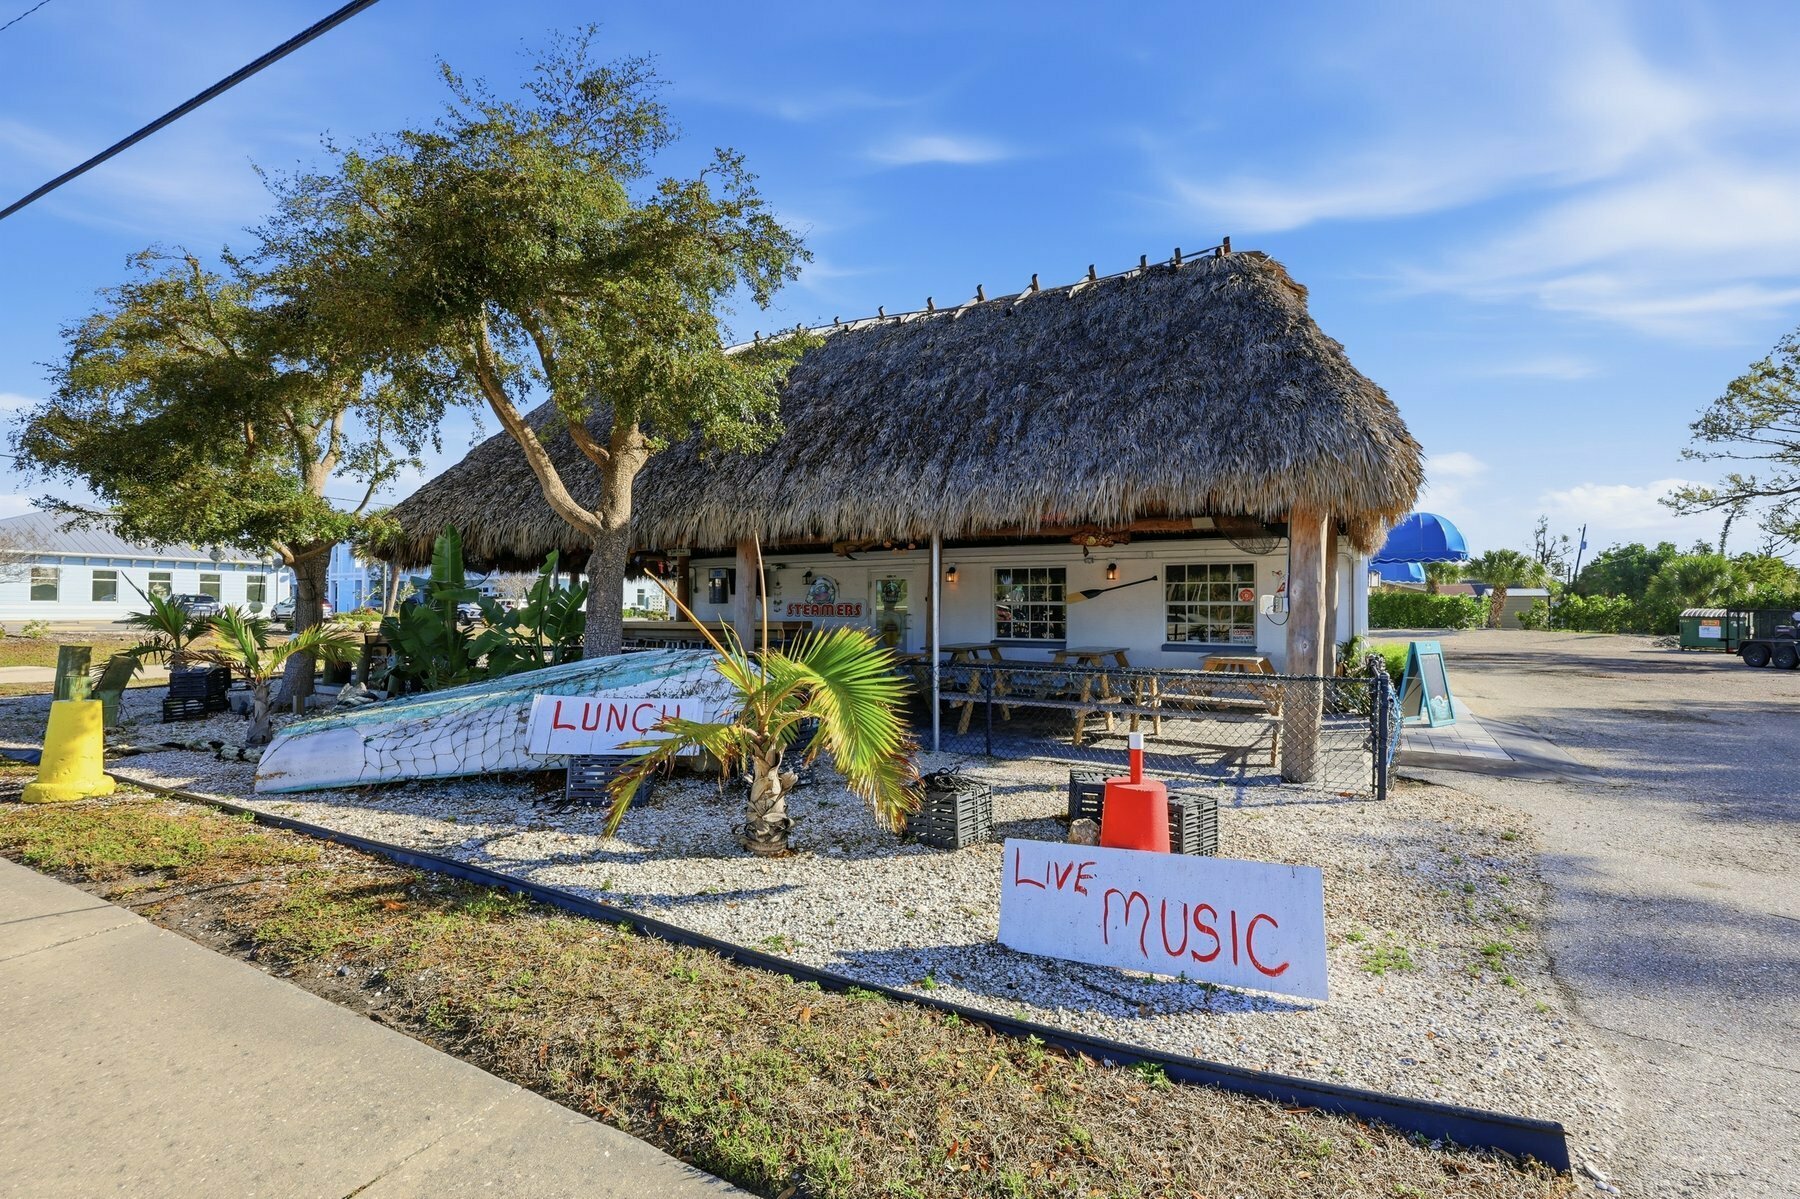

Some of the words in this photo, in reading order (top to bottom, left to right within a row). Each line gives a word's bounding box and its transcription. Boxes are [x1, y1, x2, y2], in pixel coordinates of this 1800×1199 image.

[786, 603, 863, 617] STEAMERS
[1015, 847, 1097, 896] LIVE
[1103, 888, 1290, 977] MUSIC
